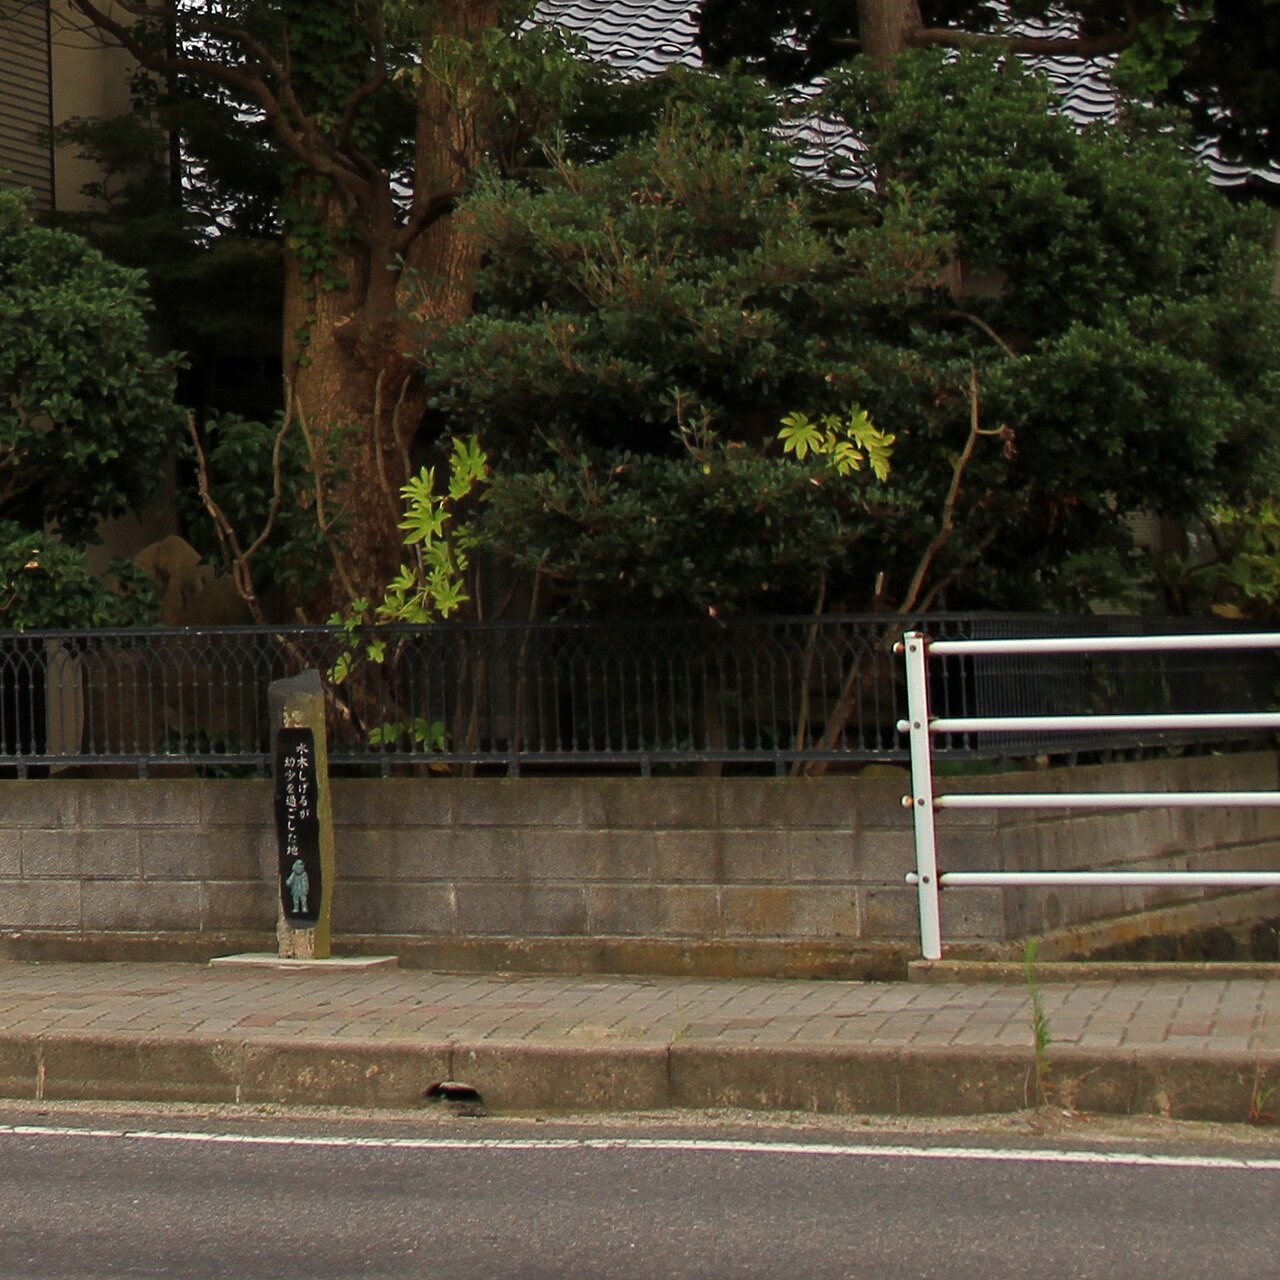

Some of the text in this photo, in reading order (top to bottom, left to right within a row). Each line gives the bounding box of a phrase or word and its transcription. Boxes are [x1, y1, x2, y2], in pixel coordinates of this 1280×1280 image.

[296, 742, 310, 820] 水木しげるが
